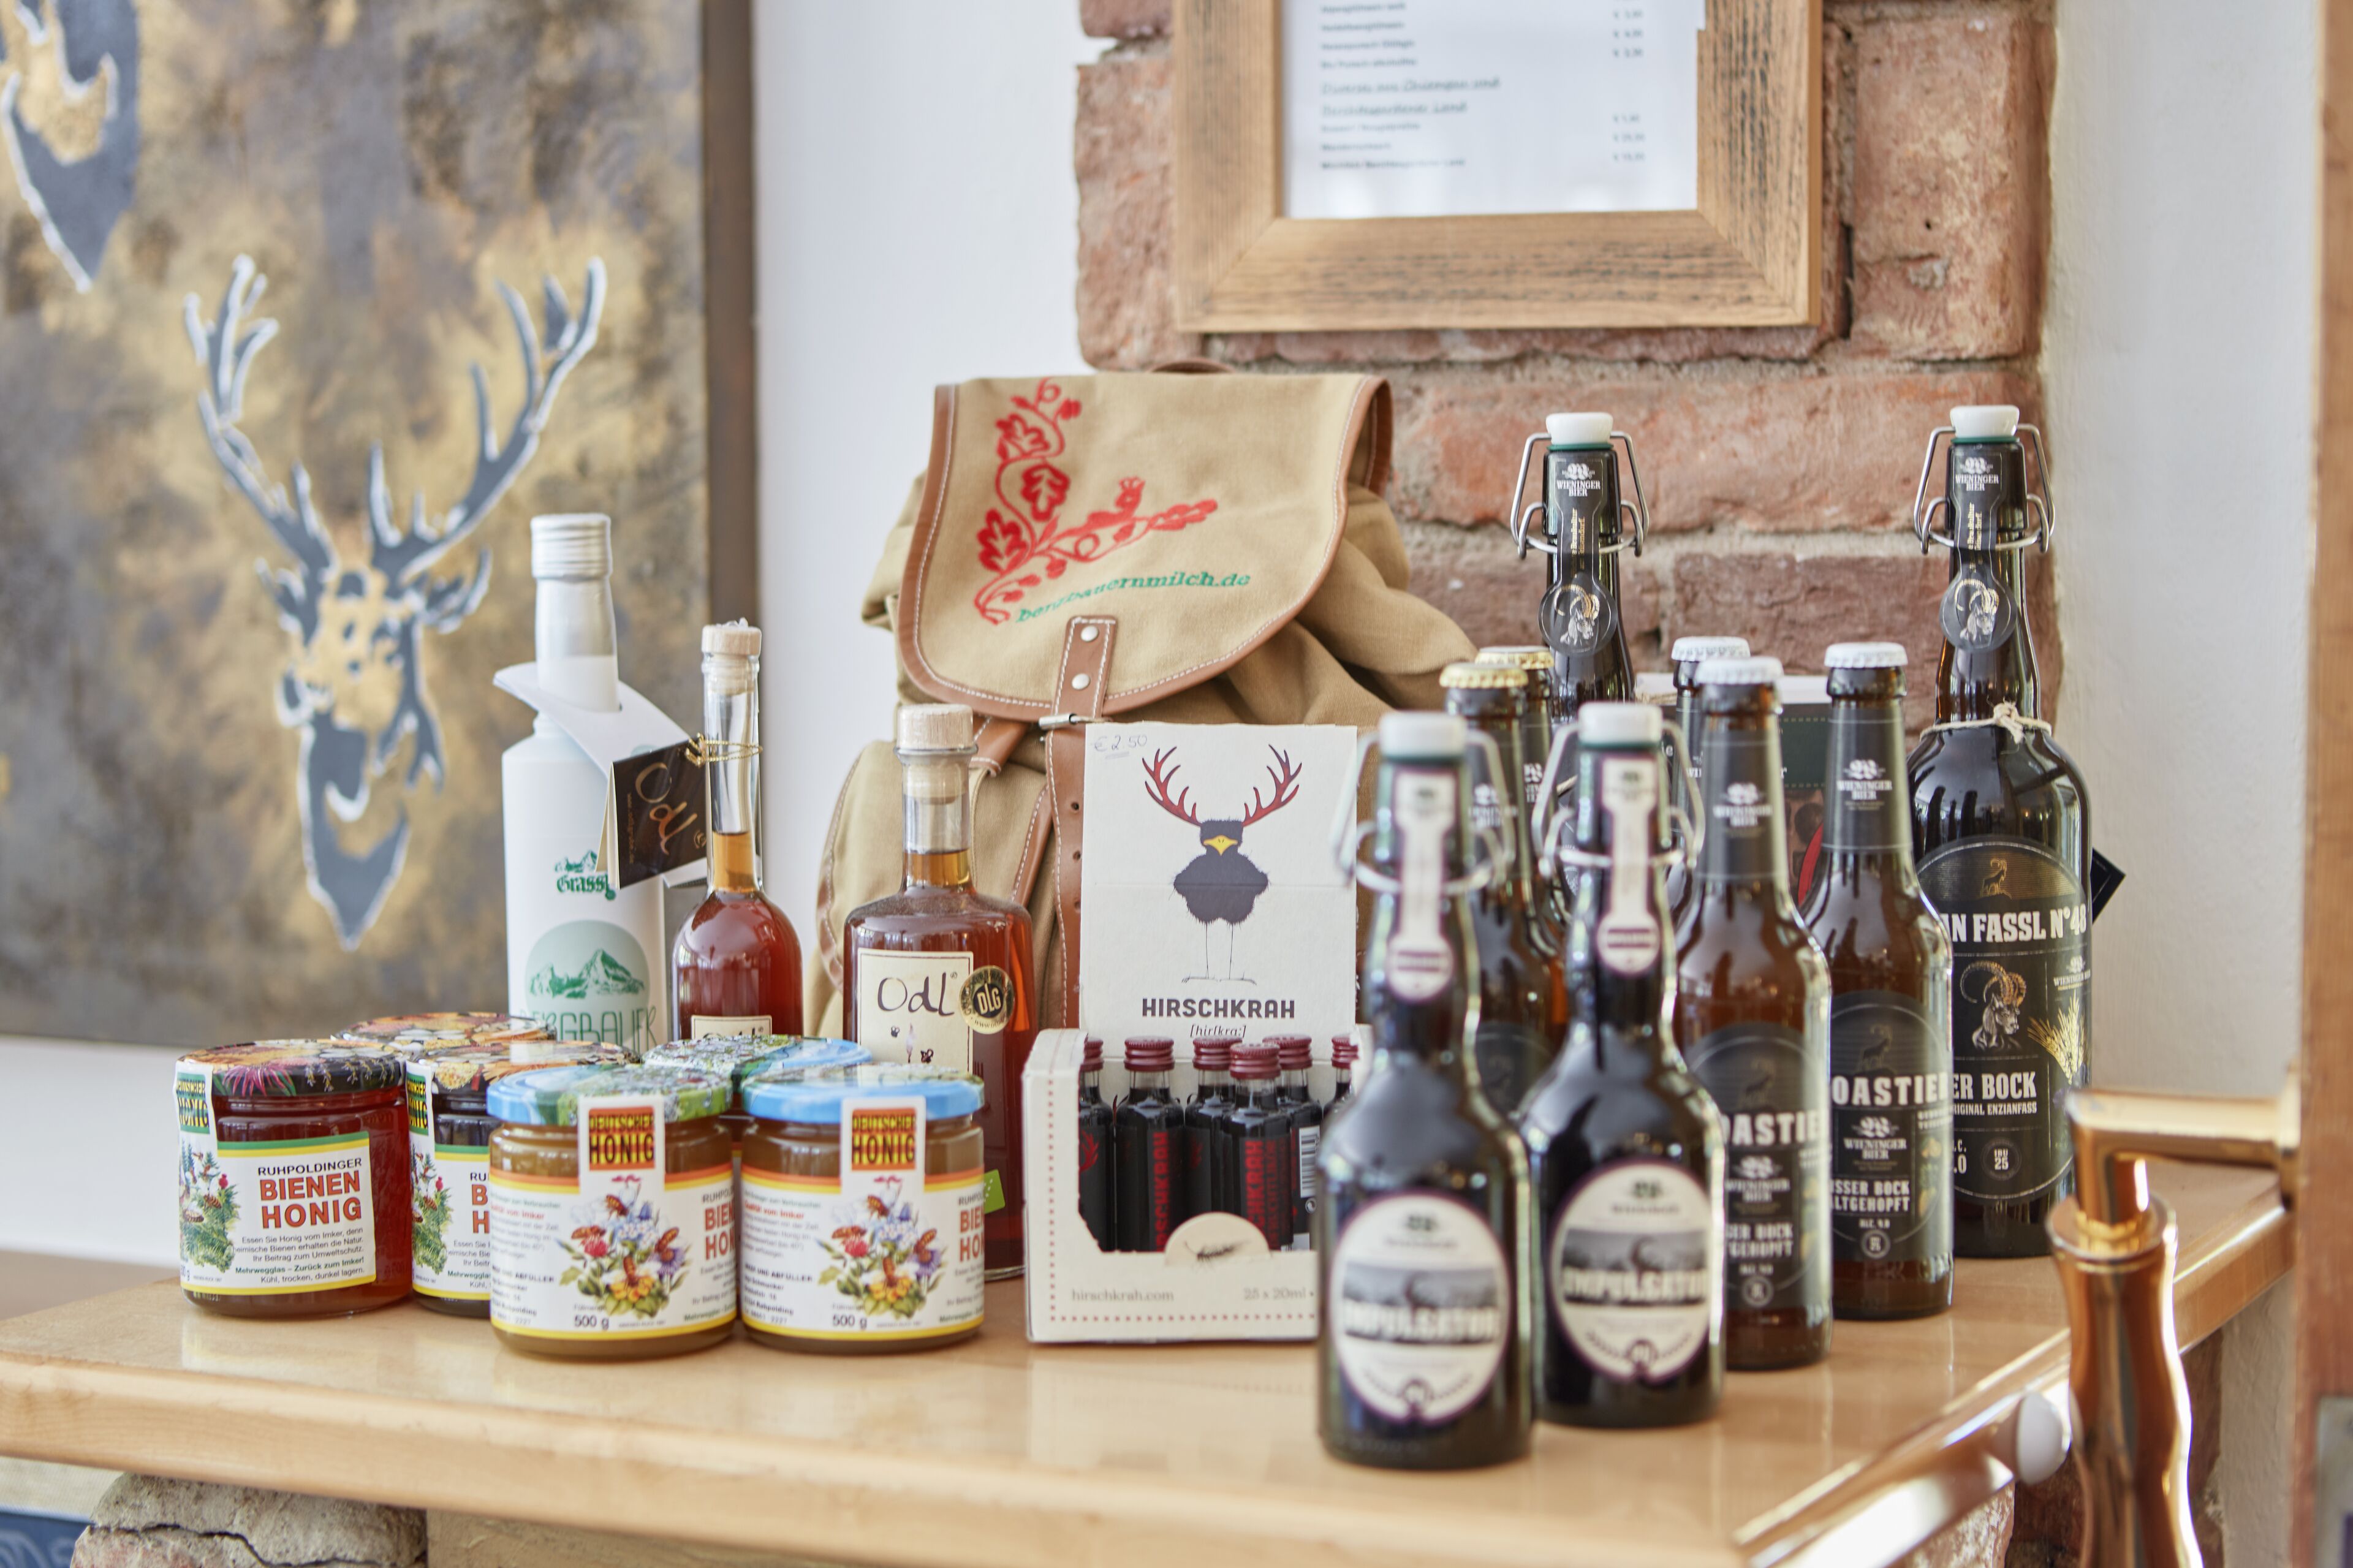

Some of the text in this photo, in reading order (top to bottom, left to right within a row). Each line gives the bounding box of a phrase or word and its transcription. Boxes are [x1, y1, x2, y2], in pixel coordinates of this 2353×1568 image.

[1556, 480, 1601, 490] WIENINGER
[1955, 474, 1999, 484] WIENINGER
[1015, 571, 1251, 624] bergbauernmilch.de
[1836, 780, 1893, 791] WIENINGER
[1851, 790, 1877, 800] BIER
[1972, 911, 2047, 943] FASSL
[877, 971, 955, 1017] Odl
[977, 983, 1002, 1015] DLG
[1142, 998, 1295, 1018] HIRSCHKRAH
[1982, 1071, 2037, 1100] BOCK
[1987, 1101, 2037, 1115] ENZIANFASS
[589, 1134, 654, 1163] HONIG
[852, 1134, 914, 1164] HONIG
[1843, 1138, 1907, 1149] WIENINGER
[1862, 1149, 1889, 1160] BIER
[257, 1157, 362, 1176] RUHPOLDINGER
[1994, 1157, 2009, 1170] 25
[260, 1170, 361, 1201] BIENEN
[1873, 1180, 1910, 1195] BOCK
[262, 1197, 362, 1229] HONIG
[522, 1209, 545, 1220] Imker
[279, 1235, 302, 1244] Honig
[322, 1229, 344, 1239] Imker,
[346, 1227, 363, 1237] denn
[270, 1243, 296, 1252] Bienen
[298, 1241, 329, 1251] erhalten
[331, 1239, 342, 1248] die
[344, 1237, 363, 1246] Natur.
[453, 1240, 487, 1249] Essen Sie
[253, 1254, 262, 1263] Ihr
[265, 1253, 292, 1263] Beitrag
[312, 1246, 364, 1259] Umweltschutz.
[235, 1265, 286, 1275] Mehrwegglas
[294, 1262, 322, 1273] Zurück
[342, 1256, 365, 1267] Imker!
[261, 1267, 365, 1284] Kühl, trocken, dunkel lagern.
[469, 1280, 488, 1289] Kühl,
[1243, 1286, 1306, 1300] 25 x 20ml
[1071, 1287, 1175, 1304] hirschkrah.com
[574, 1314, 610, 1331] 500 g
[833, 1314, 868, 1330] 500 g
